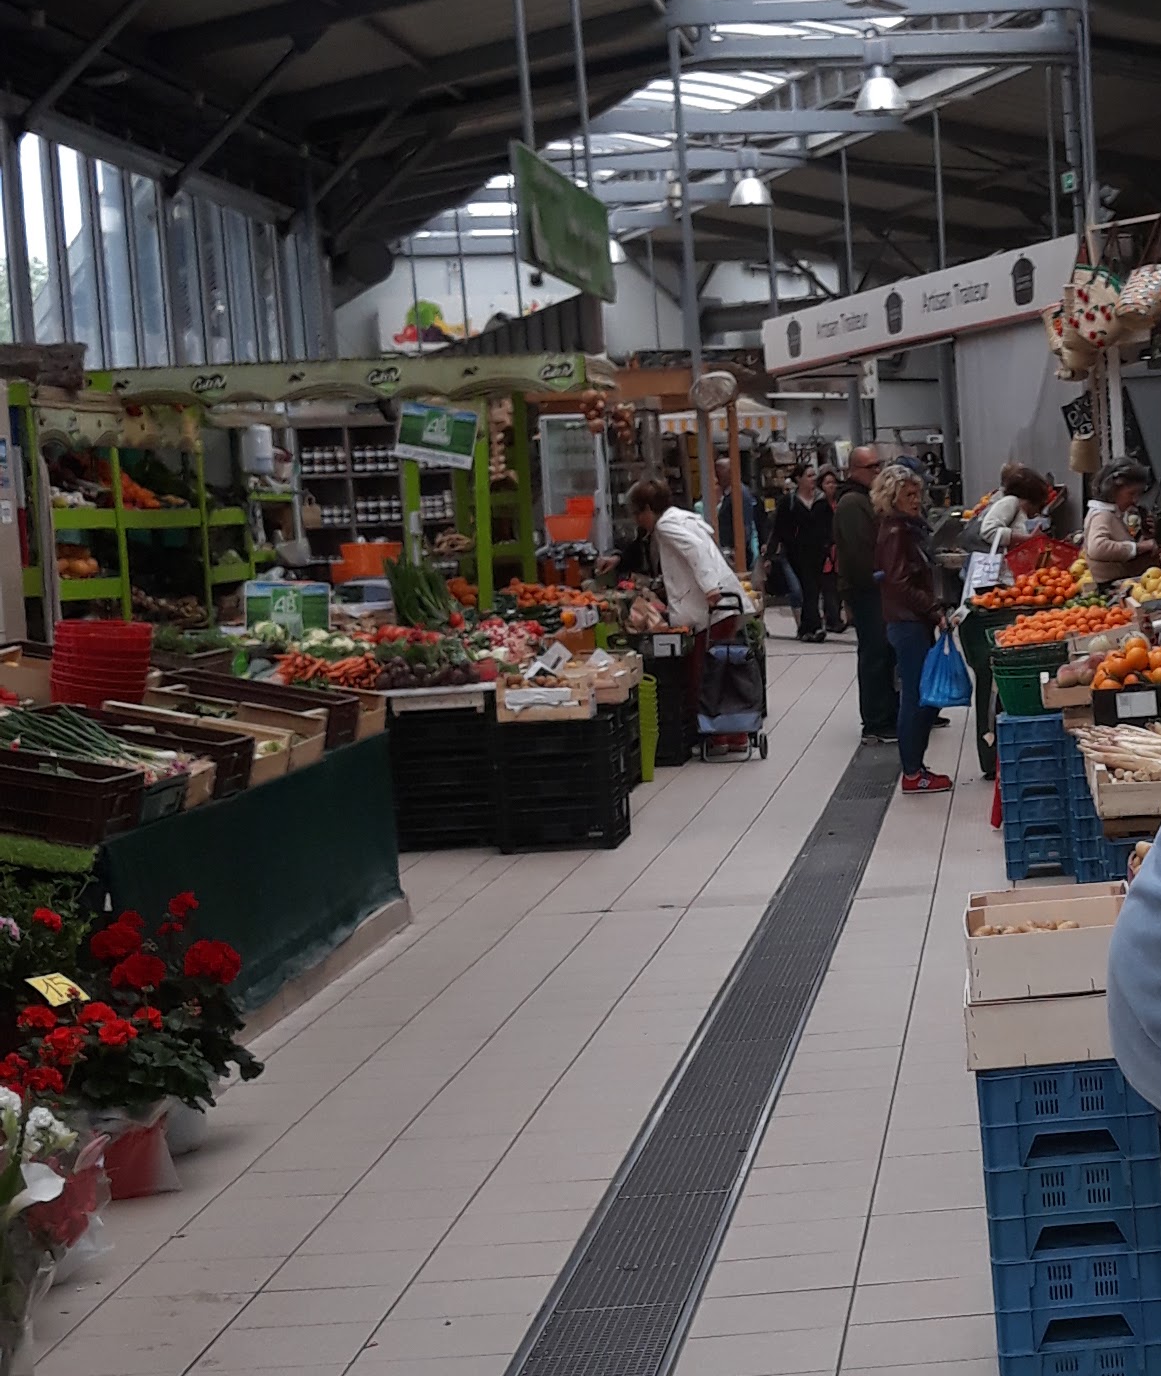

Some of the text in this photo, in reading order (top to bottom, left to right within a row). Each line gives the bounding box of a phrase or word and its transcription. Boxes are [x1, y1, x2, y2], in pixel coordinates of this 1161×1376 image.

[922, 291, 953, 314] Artisan
[952, 282, 990, 307] Traiteur
[816, 317, 840, 340] Artisan
